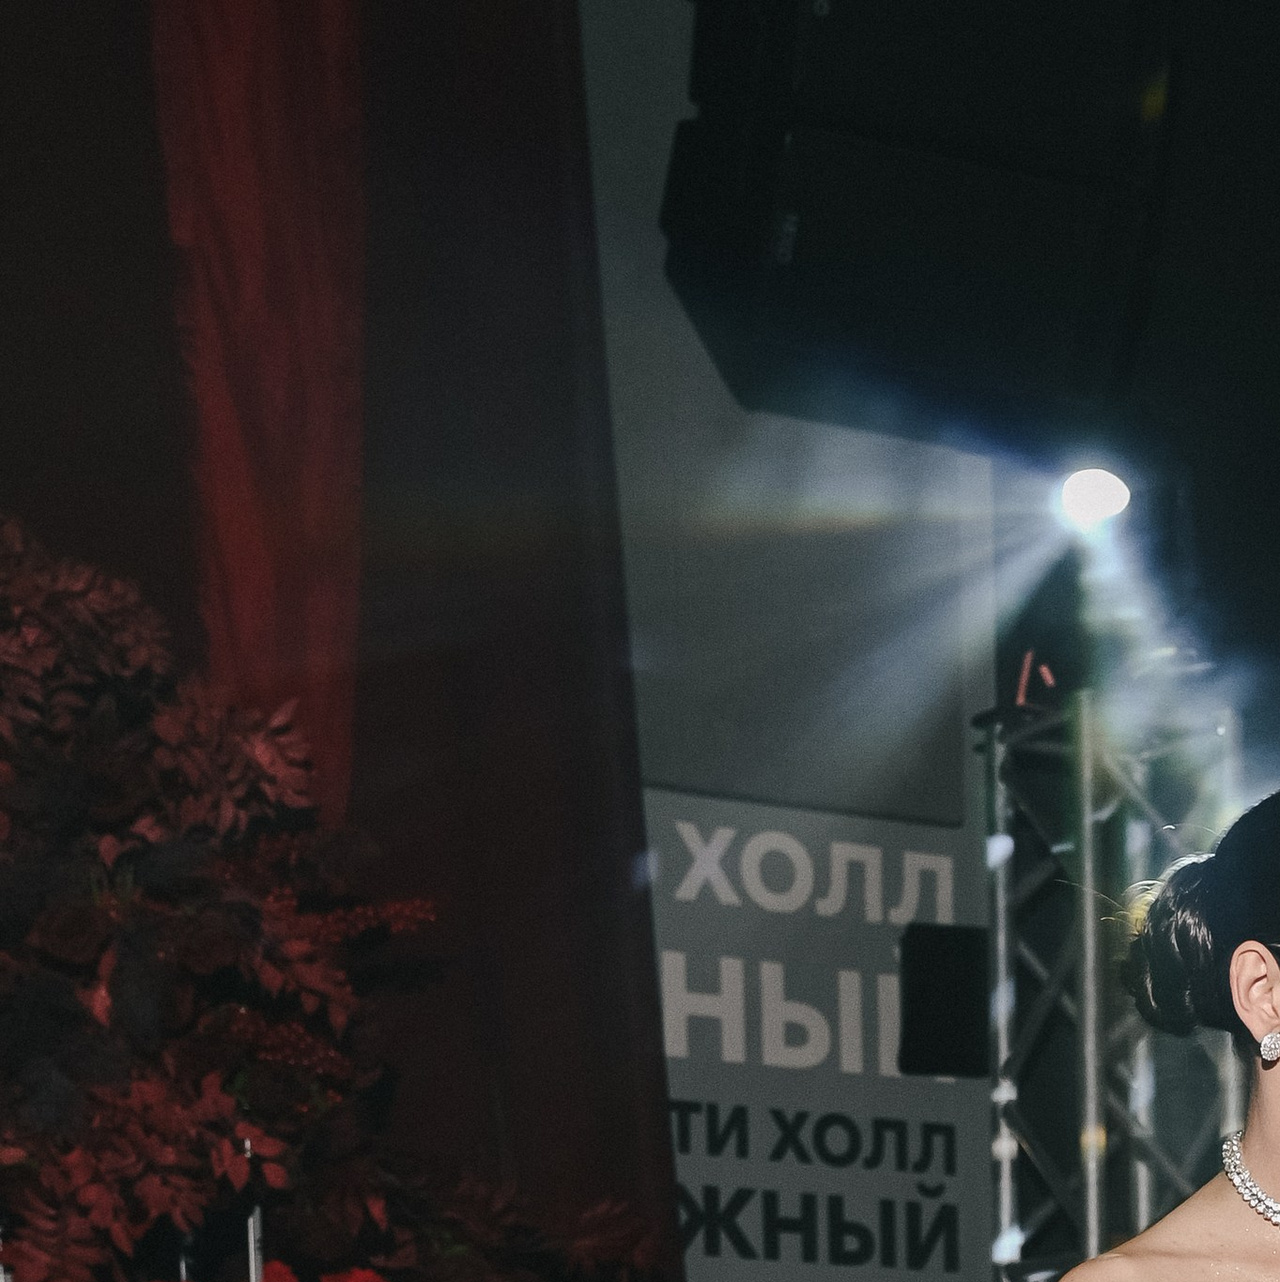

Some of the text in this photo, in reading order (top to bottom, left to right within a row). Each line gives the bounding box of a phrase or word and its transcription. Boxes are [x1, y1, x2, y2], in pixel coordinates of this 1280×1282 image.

[674, 820, 955, 924] ХОЛЛ
[661, 948, 956, 1083] НЫ
[769, 1107, 958, 1177] ХОЛЛ
